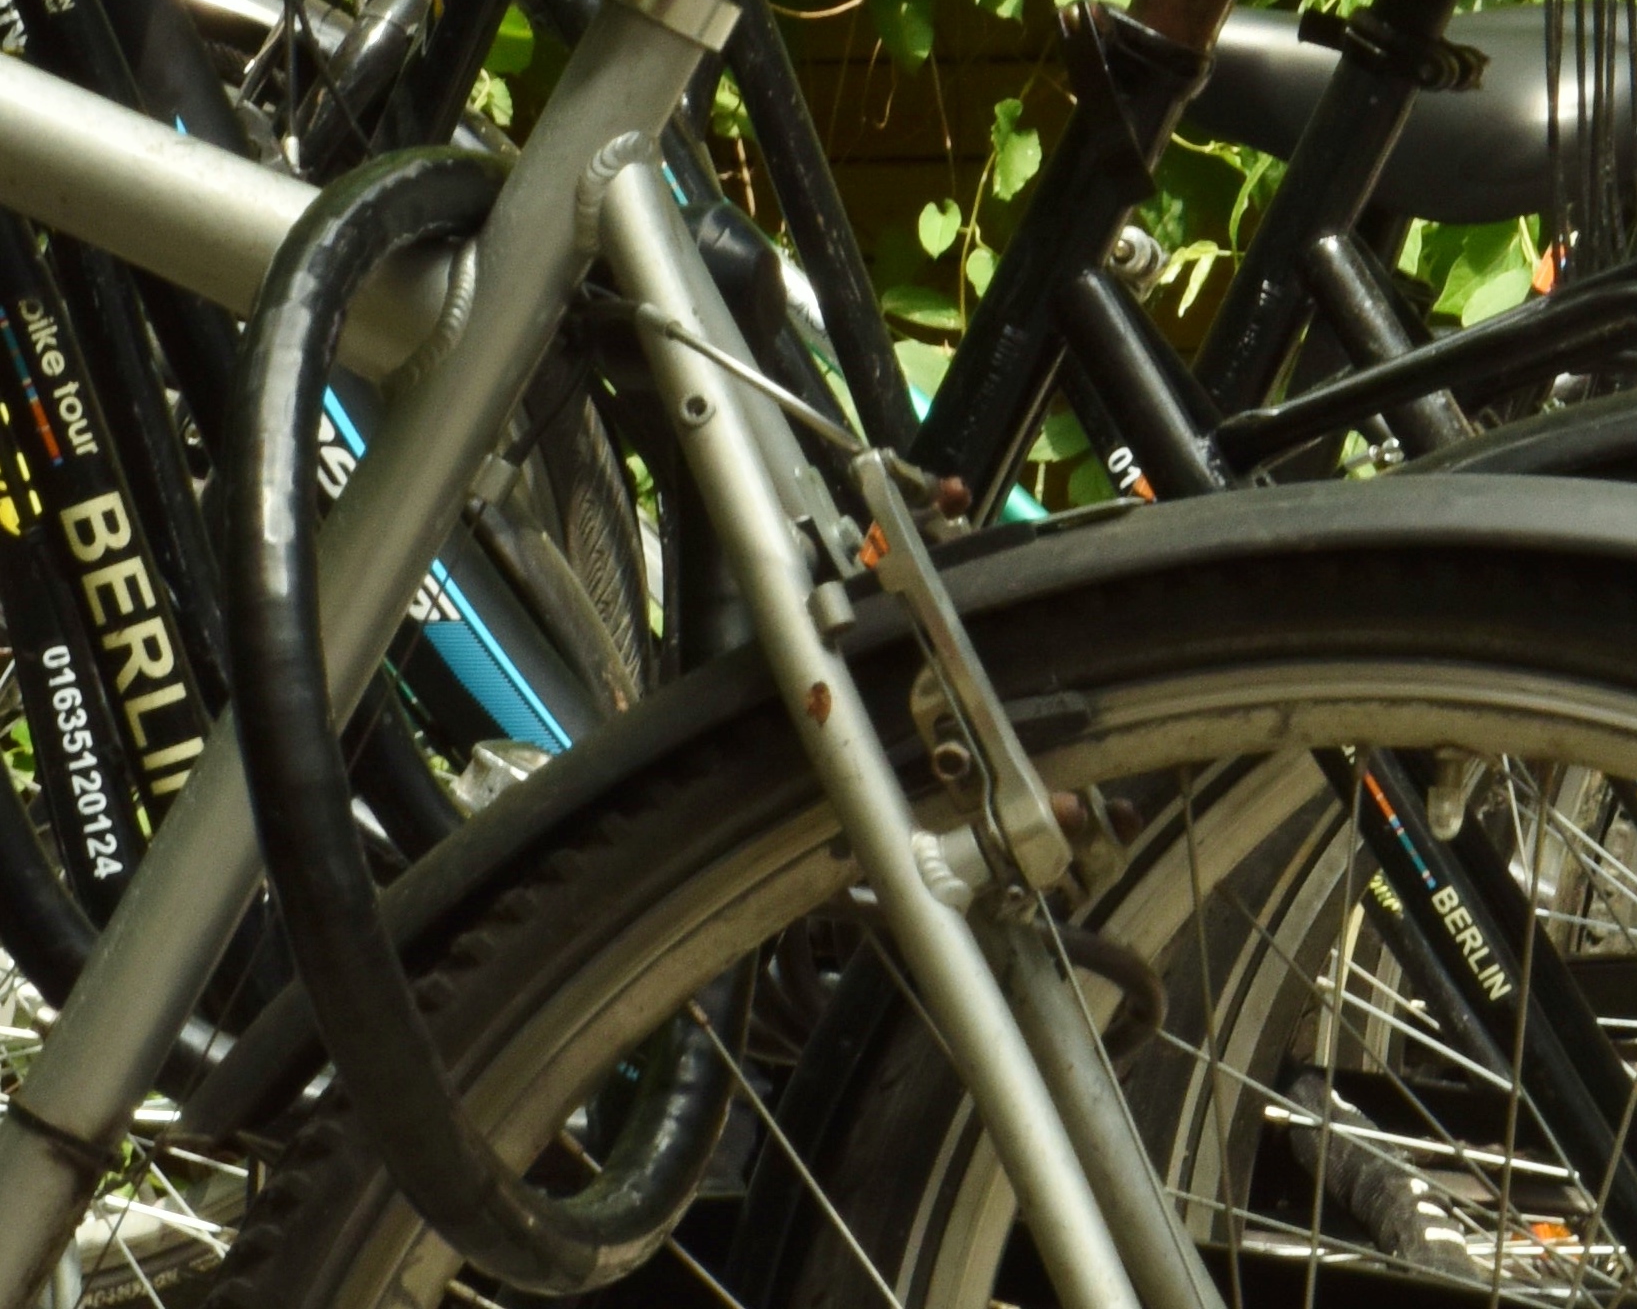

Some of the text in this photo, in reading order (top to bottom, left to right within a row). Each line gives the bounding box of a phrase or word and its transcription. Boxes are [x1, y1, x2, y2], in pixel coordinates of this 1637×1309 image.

[52, 381, 99, 456] tour
[42, 644, 124, 881] 01635120124
[1431, 884, 1513, 1002] BERLIN
